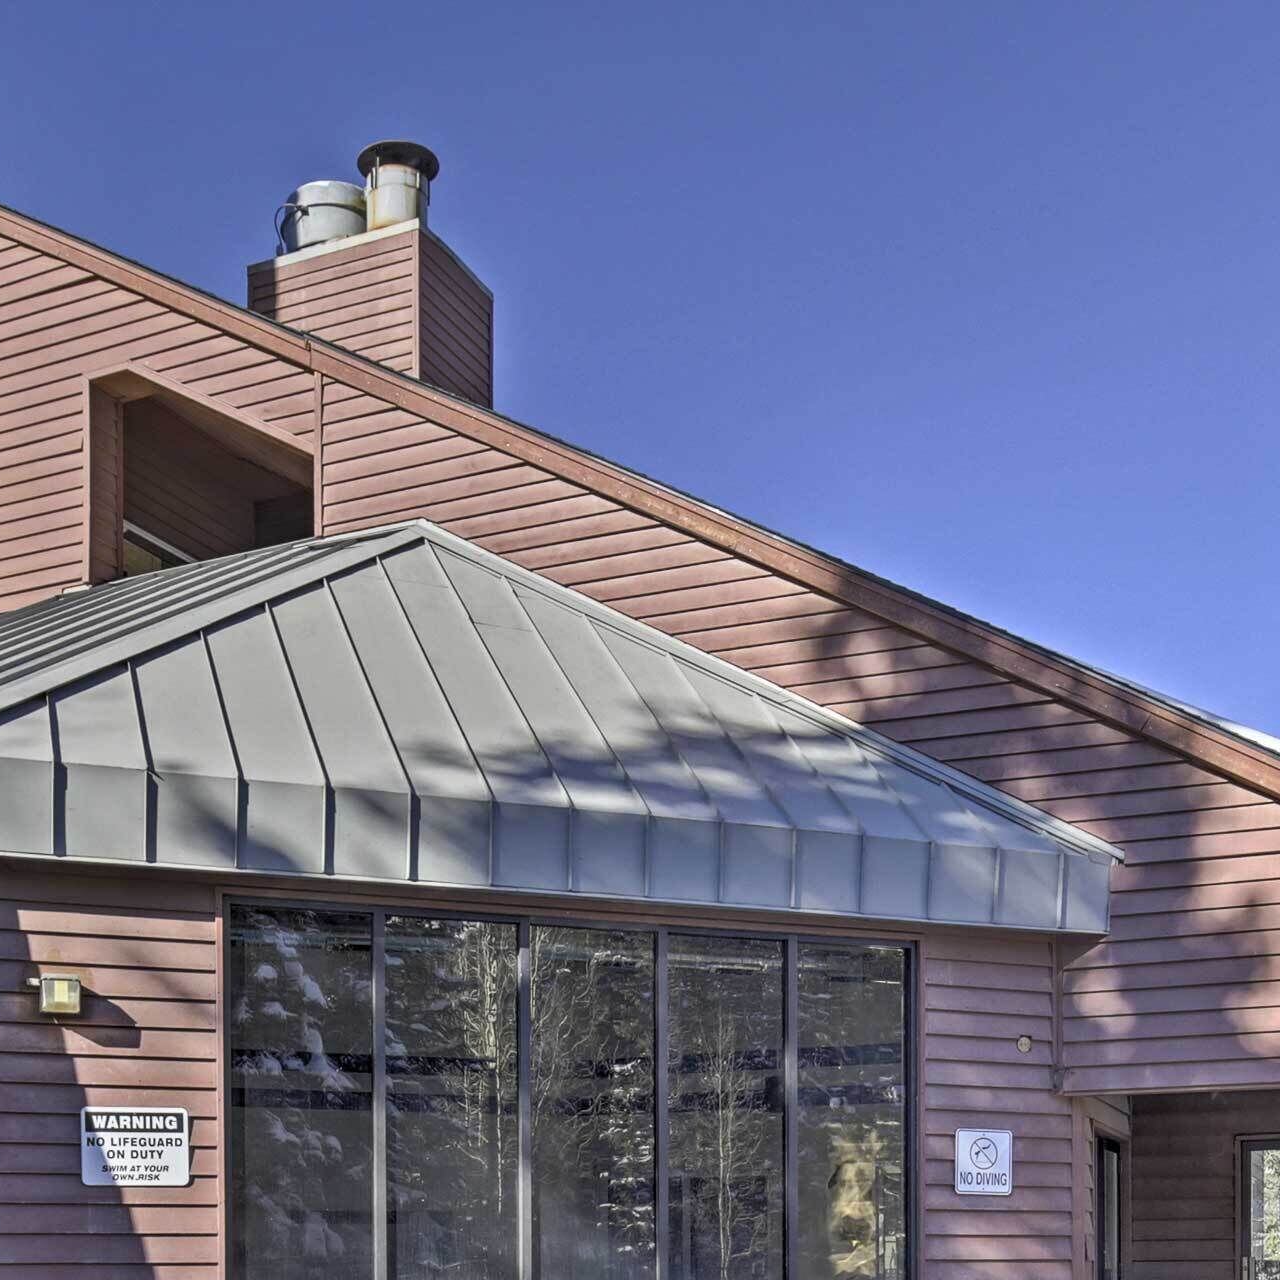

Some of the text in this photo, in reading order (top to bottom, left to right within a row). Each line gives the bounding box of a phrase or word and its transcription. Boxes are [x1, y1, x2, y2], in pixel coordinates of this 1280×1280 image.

[92, 1115, 178, 1130] WARNING
[86, 1137, 183, 1147] NO LIFEGUARD
[107, 1150, 164, 1159] ON DUTY
[959, 1172, 1007, 1186] NO DIVING
